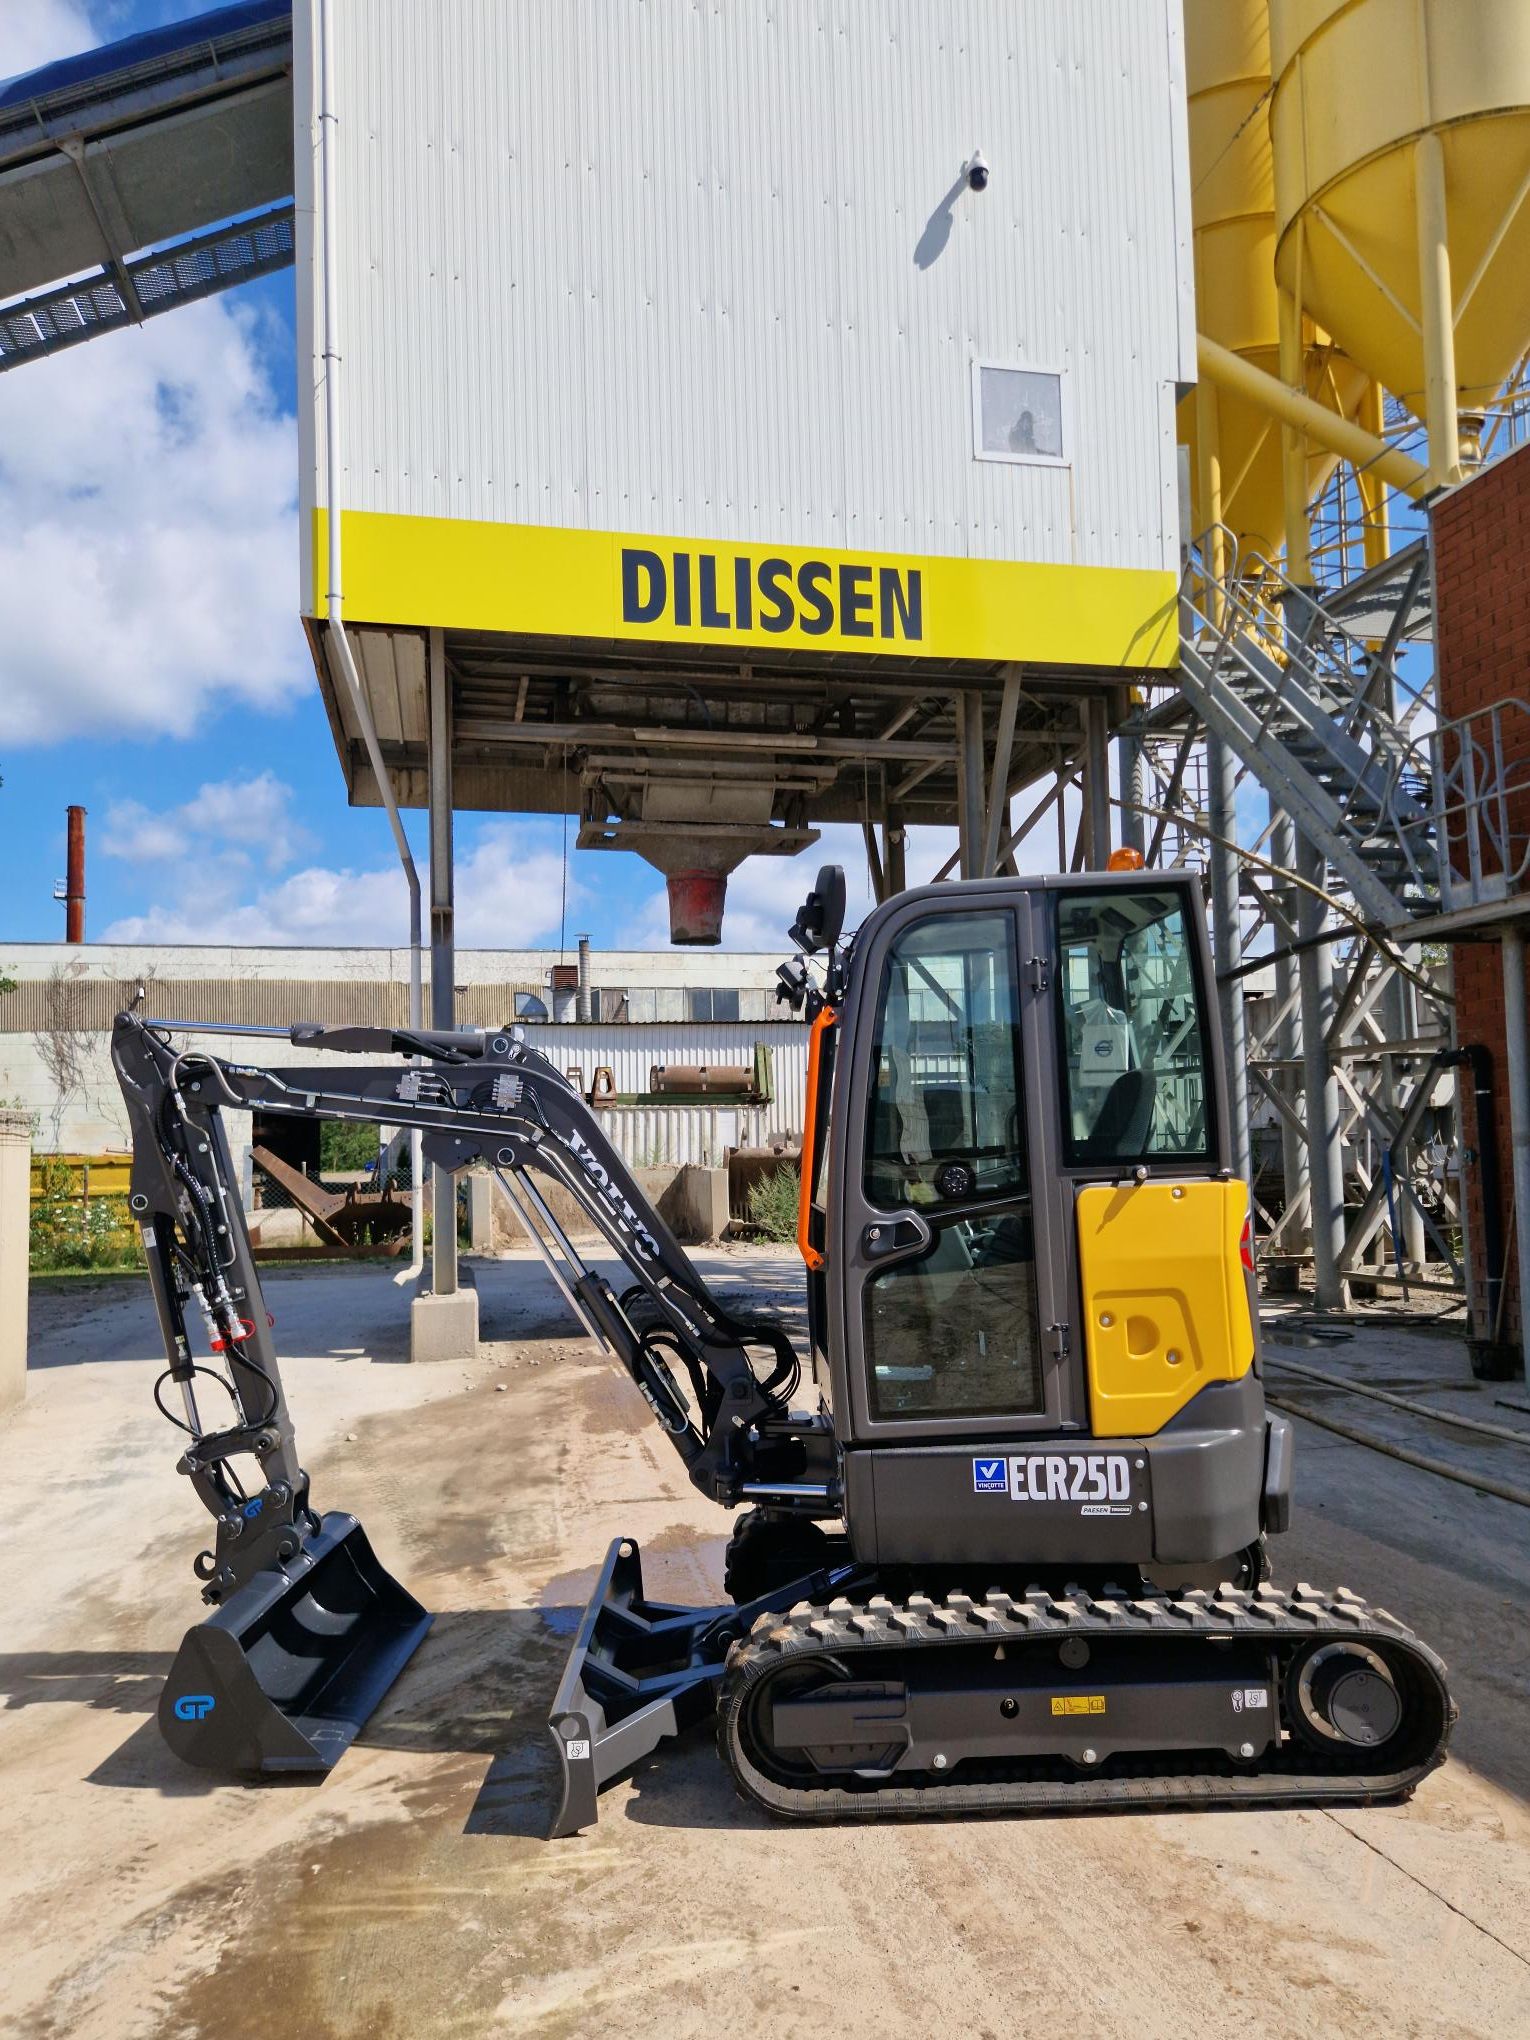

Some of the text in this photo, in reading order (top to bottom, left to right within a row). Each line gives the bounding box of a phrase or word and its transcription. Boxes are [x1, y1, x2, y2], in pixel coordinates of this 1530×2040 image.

[622, 548, 922, 641] DILISSEN
[569, 1128, 660, 1261] VOLVO
[1009, 1456, 1130, 1500] ECR25D
[175, 1695, 215, 1719] GP
